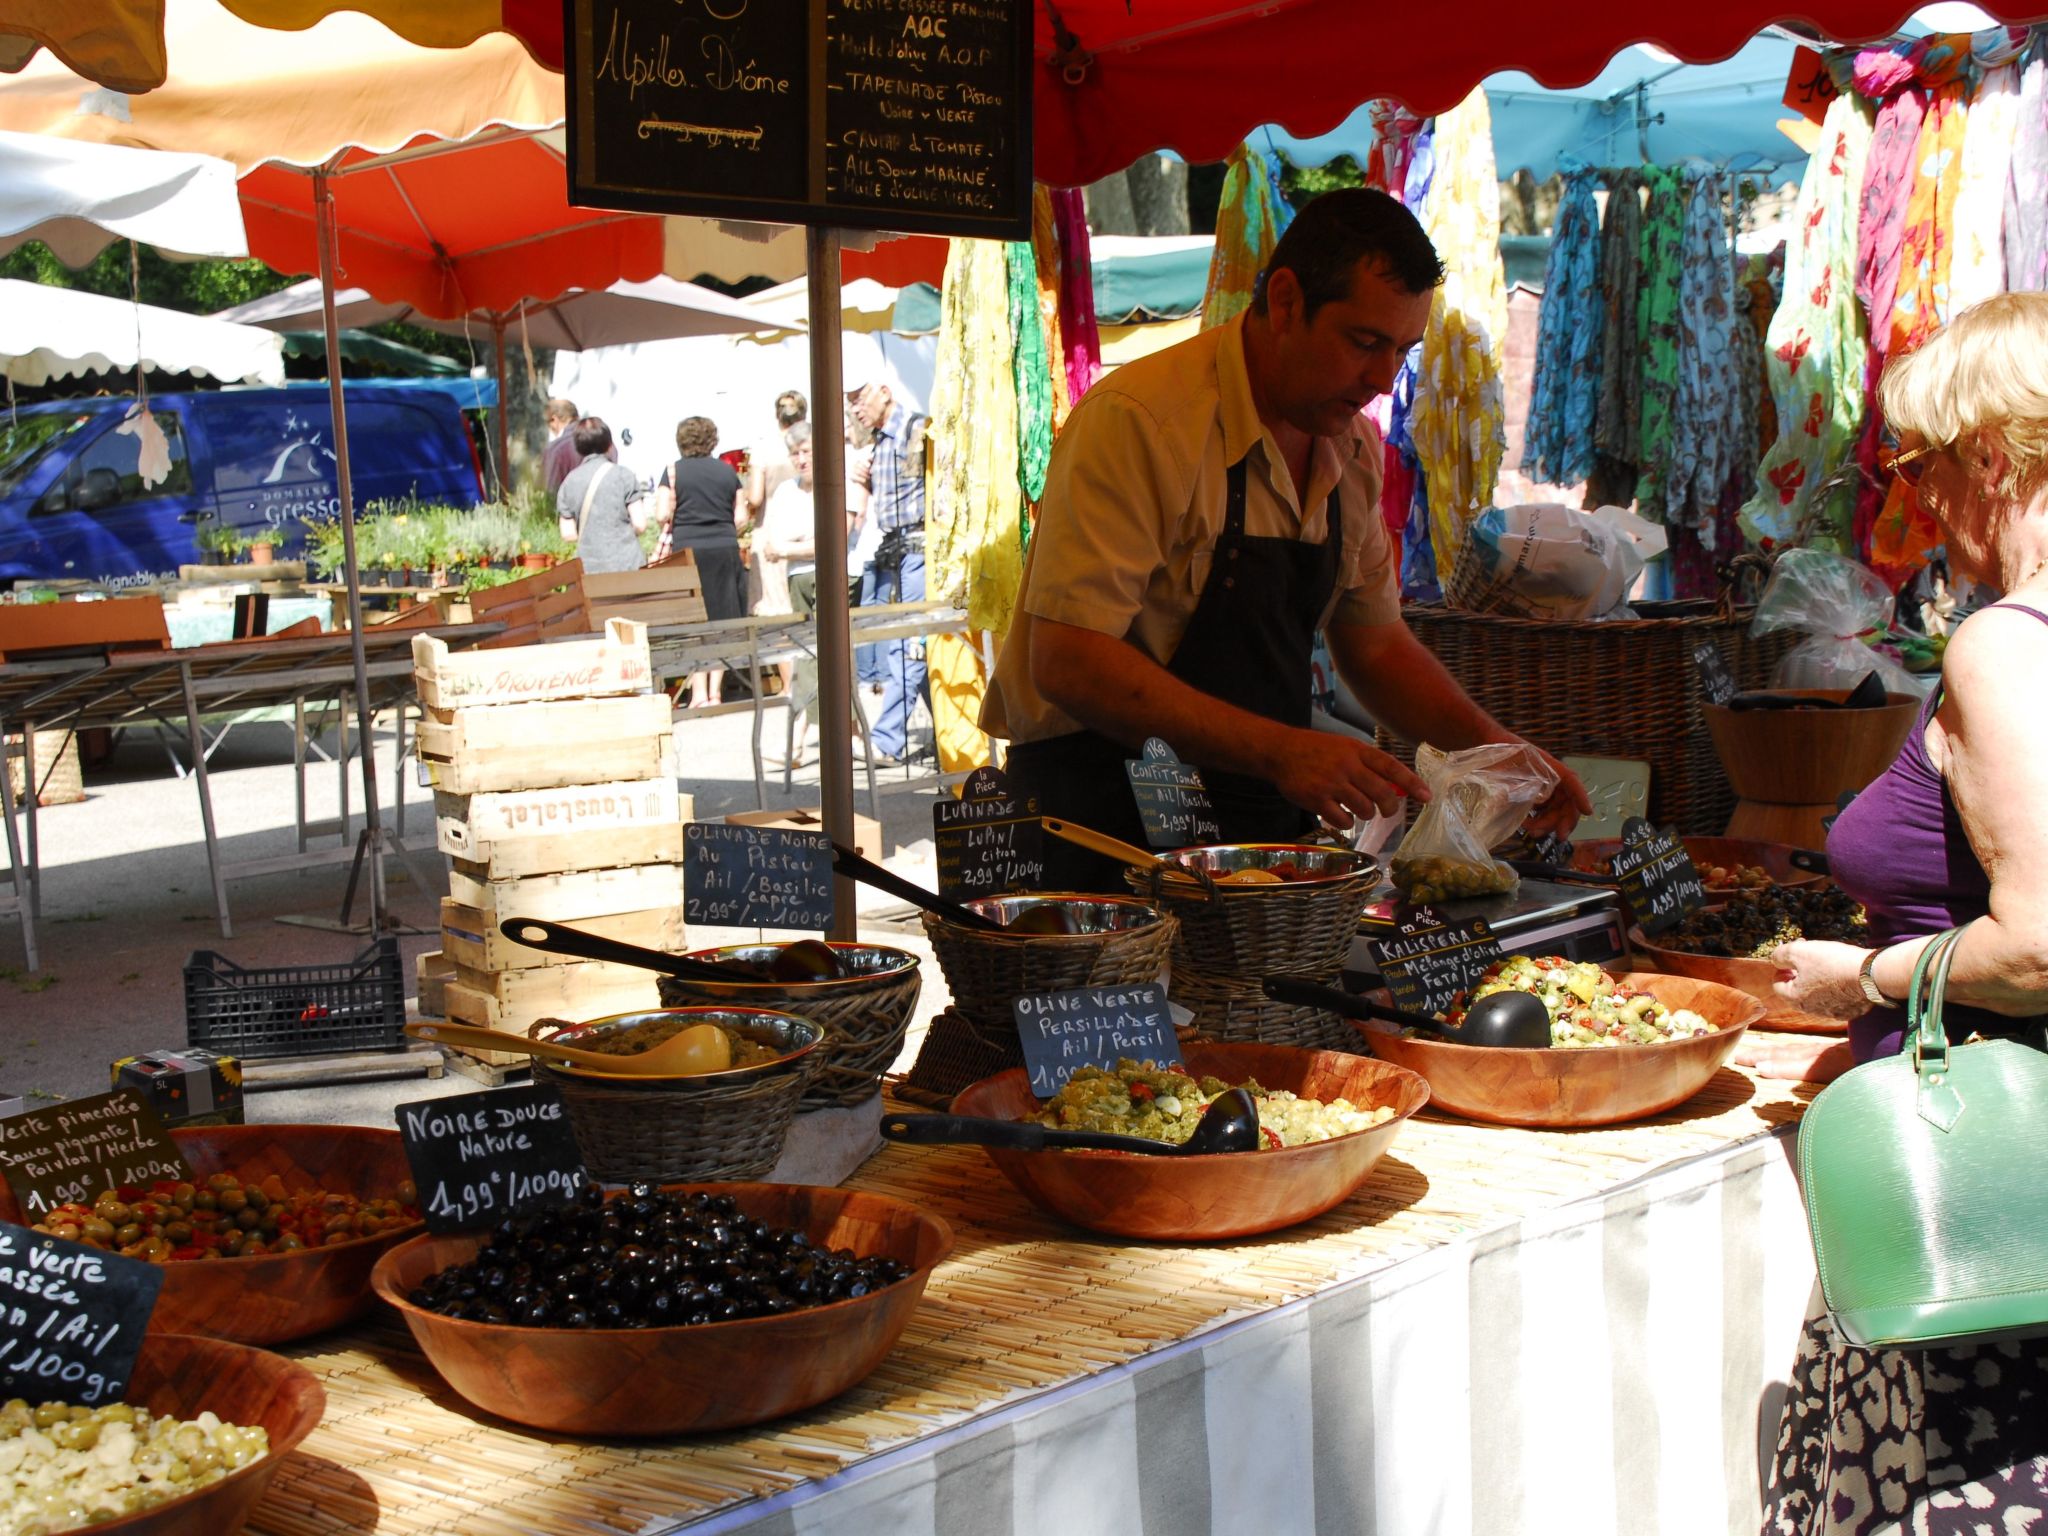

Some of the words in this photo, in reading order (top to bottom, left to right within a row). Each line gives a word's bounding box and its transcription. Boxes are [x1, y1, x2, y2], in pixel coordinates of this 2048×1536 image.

[701, 34, 790, 95] Drôme
[845, 71, 949, 101] TAPENADE
[845, 154, 874, 177] AIL
[263, 485, 331, 502] DOMAINE
[975, 781, 997, 794] Pièce
[942, 801, 1016, 822] LUPINADE
[699, 845, 721, 863] Au
[748, 845, 815, 873] Pistou
[704, 869, 732, 889] Ail
[1092, 989, 1155, 1008] VERTE
[1062, 1036, 1089, 1057] Ail
[1112, 1028, 1164, 1050] Persil
[406, 1105, 490, 1143] NOIRE
[495, 1102, 563, 1128] DOUCE
[458, 1131, 533, 1163] Nature
[25, 1153, 91, 1179] Poivron
[29, 1246, 107, 1283] Verte
